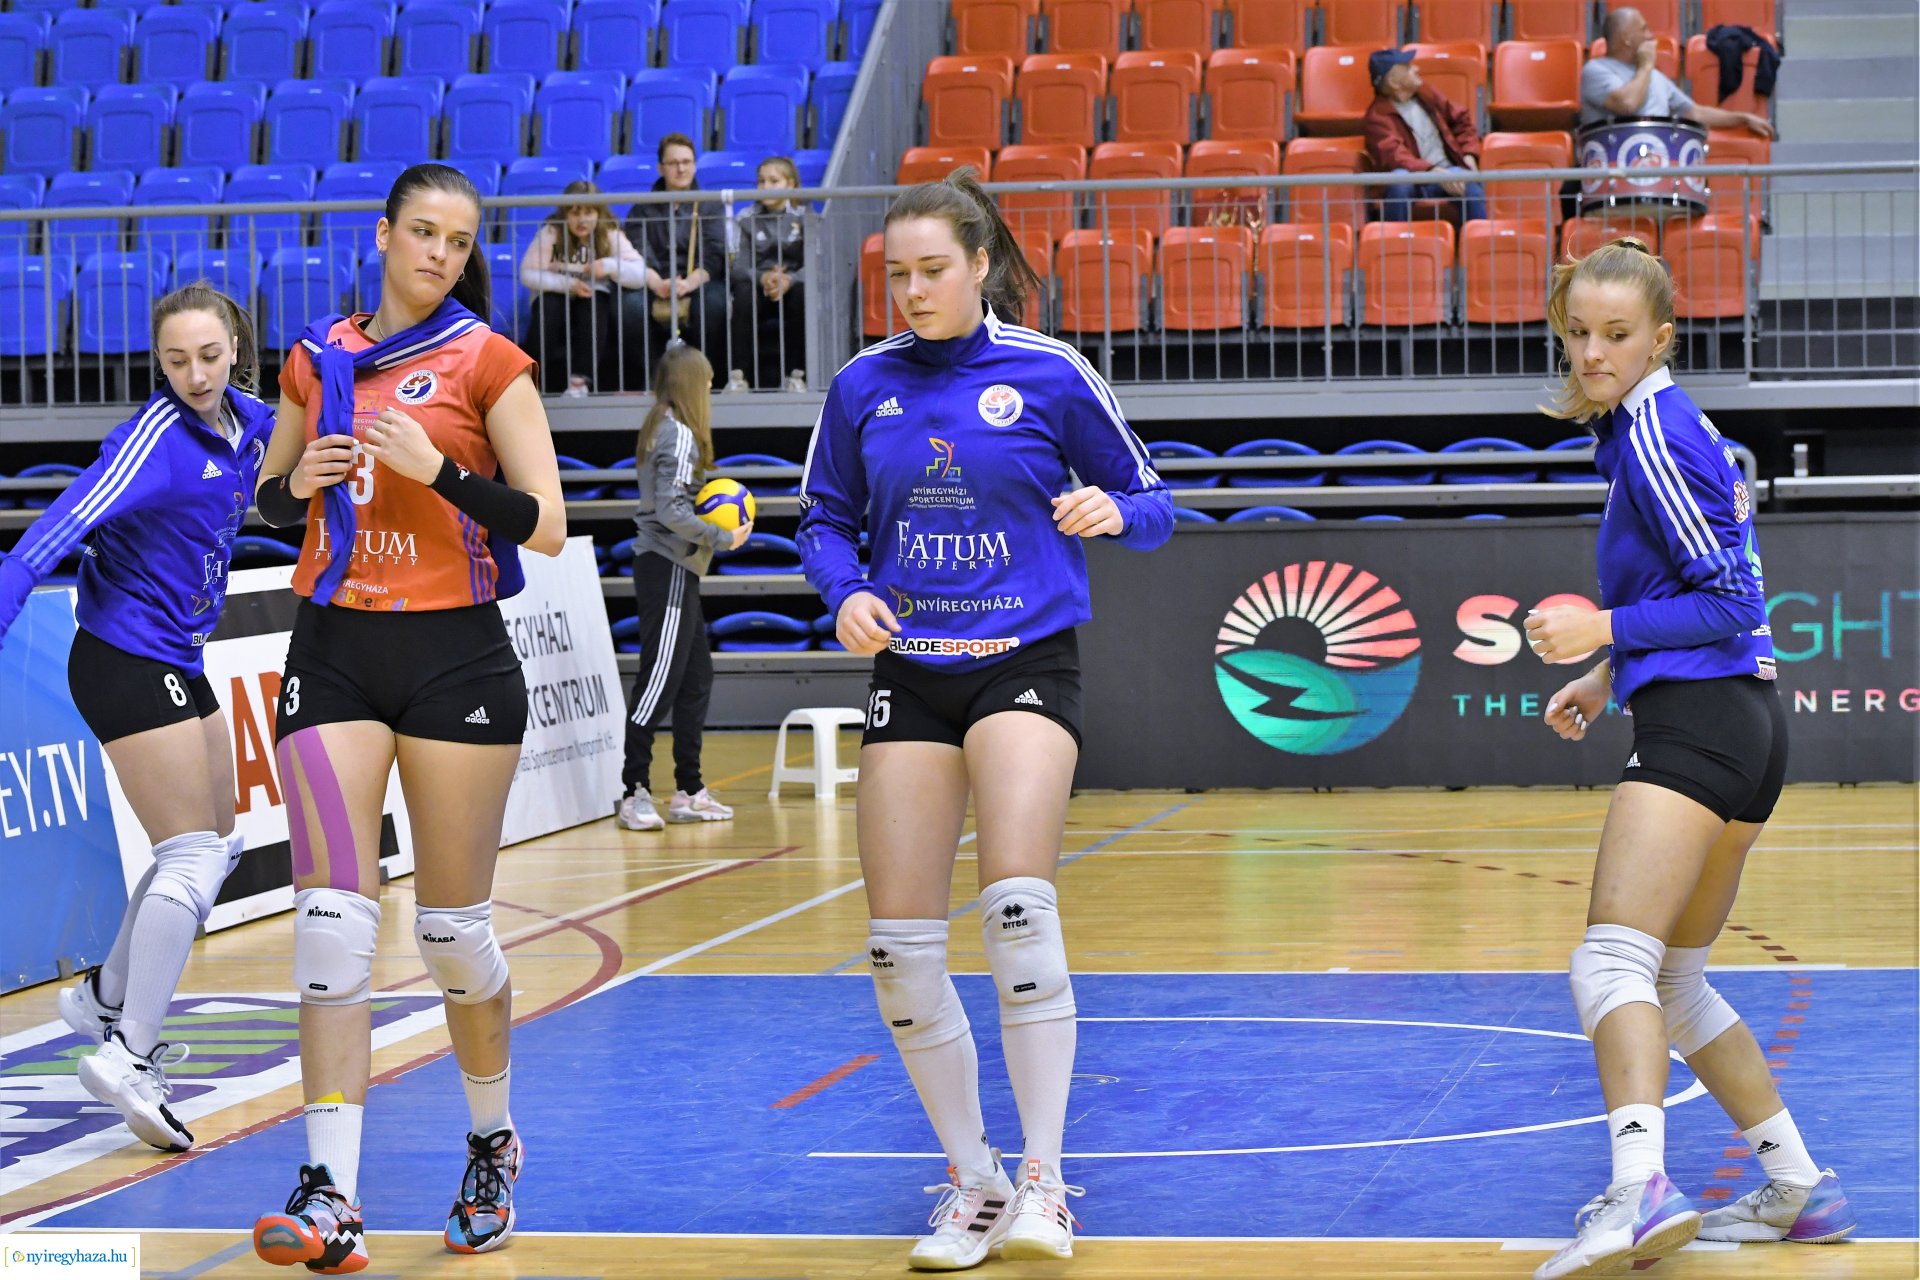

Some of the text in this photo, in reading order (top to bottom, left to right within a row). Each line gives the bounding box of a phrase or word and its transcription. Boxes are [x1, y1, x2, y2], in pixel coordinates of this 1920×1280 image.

[875, 406, 904, 417] adidas
[201, 469, 223, 480] adidas
[348, 444, 375, 505] 3
[912, 486, 967, 495] NYÍREGYHÁZI
[908, 496, 975, 505] SPORTCENTRUM
[314, 518, 419, 557] FTUM
[896, 519, 1012, 562] FATUM
[314, 552, 418, 566] PRPERTY
[896, 556, 1012, 571] PROPERTY
[916, 594, 1025, 613] NYÍREGYHÁZA
[889, 639, 1011, 654] BLADESPORT
[163, 673, 187, 707] 8
[285, 676, 300, 717] 3
[526, 674, 609, 732] TCENTRUM
[1014, 697, 1043, 706] adidas
[1453, 694, 1541, 716] THE
[865, 689, 892, 731] 15
[464, 716, 490, 725] adidas
[466, 1073, 507, 1086] hummel
[304, 1106, 339, 1116] ummel
[1616, 1127, 1648, 1138] adidas
[1756, 1143, 1780, 1155] adidas
